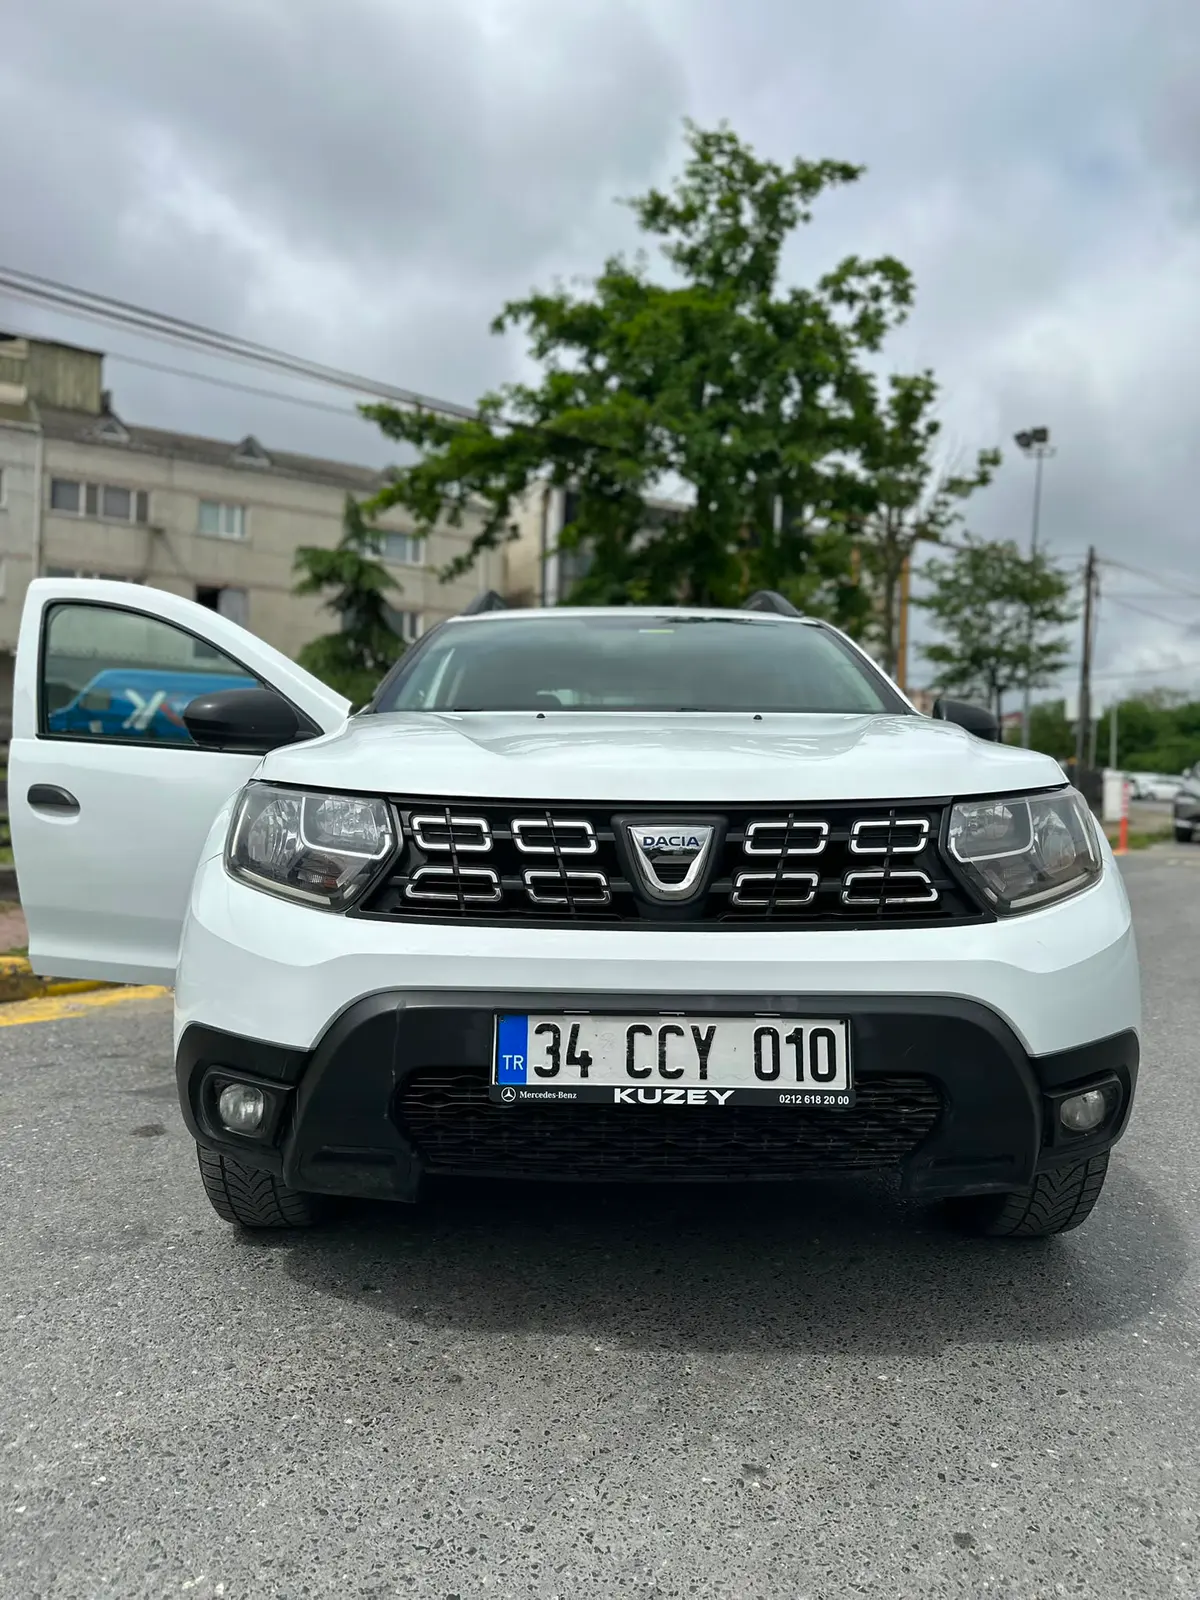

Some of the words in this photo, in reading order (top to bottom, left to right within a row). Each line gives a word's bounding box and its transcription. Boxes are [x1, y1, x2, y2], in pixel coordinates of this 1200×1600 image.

[643, 836, 700, 847] DACIA
[534, 1023, 593, 1078] 34
[626, 1024, 717, 1080] CCY
[753, 1027, 837, 1083] 010
[502, 1054, 524, 1071] TR
[519, 1090, 577, 1099] Mercedes-Benz
[614, 1088, 735, 1105] KUZEY
[779, 1094, 802, 1104] 0212
[804, 1095, 822, 1104] 618
[823, 1095, 836, 1105] 20
[837, 1095, 850, 1105] 00
